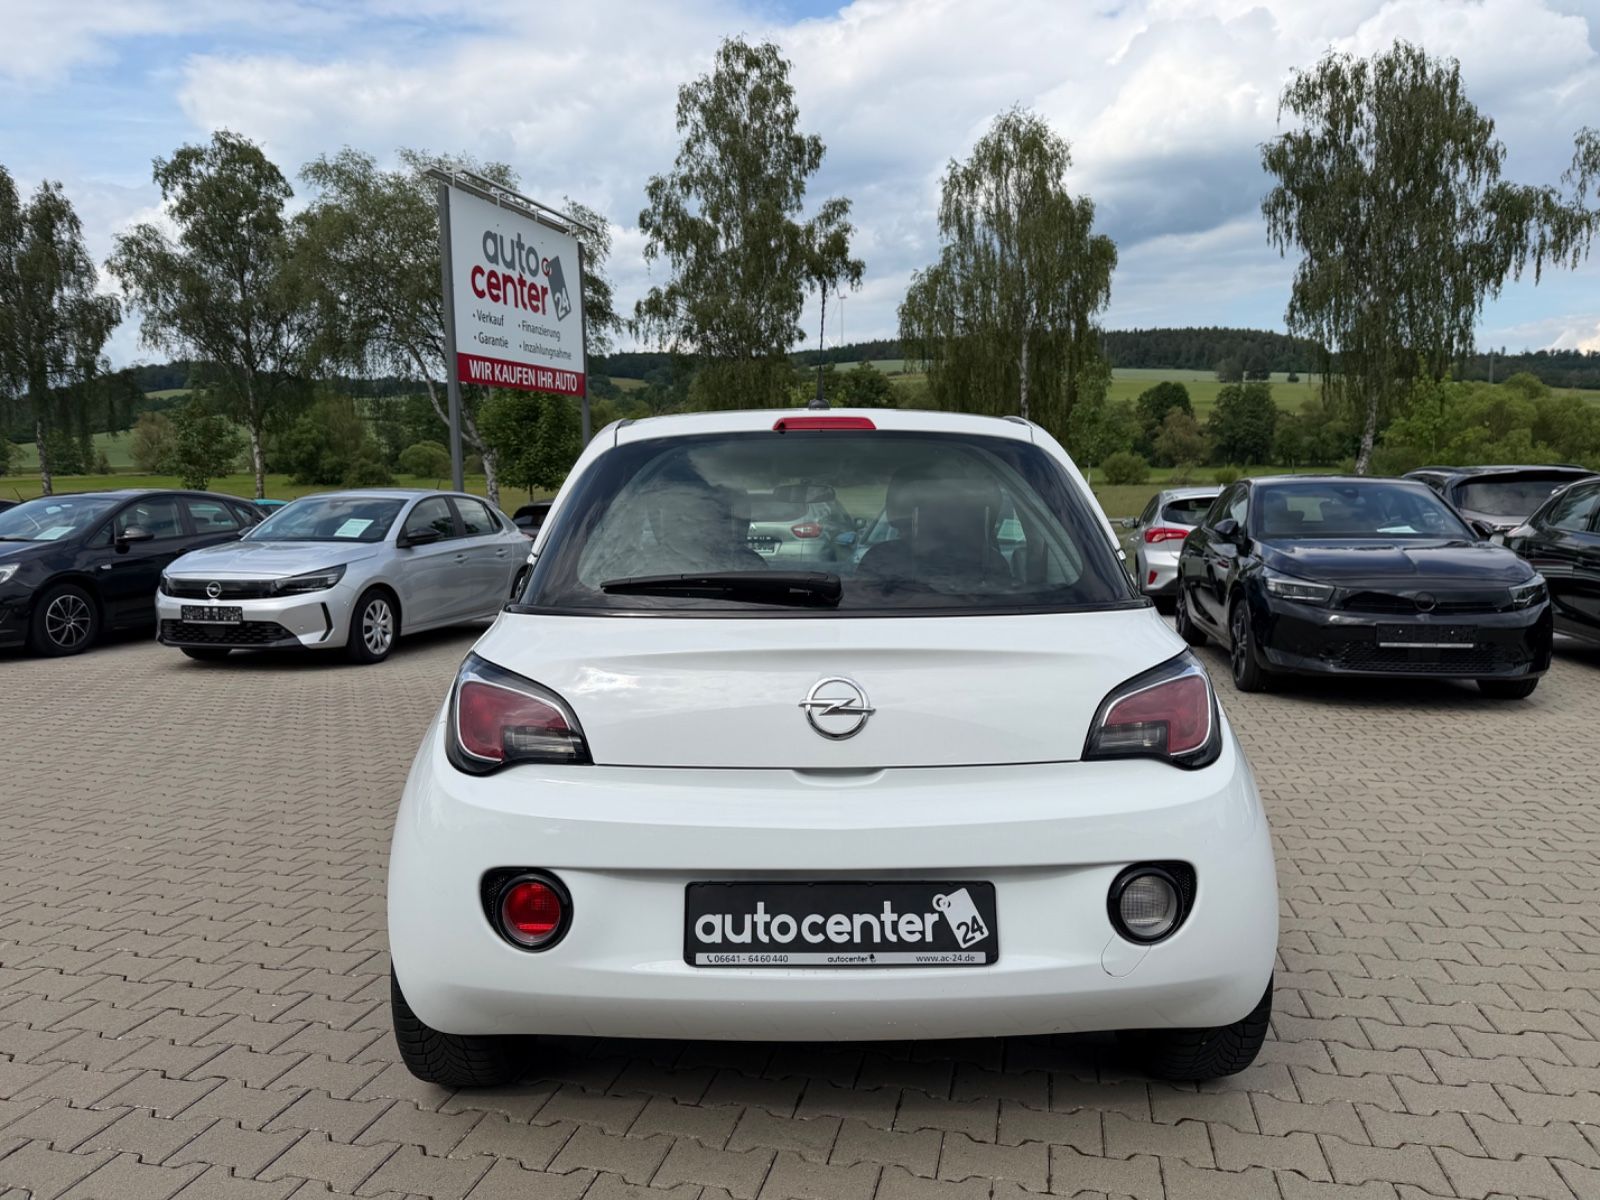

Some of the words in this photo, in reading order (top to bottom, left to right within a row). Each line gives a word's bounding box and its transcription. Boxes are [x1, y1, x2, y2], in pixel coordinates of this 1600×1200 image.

[482, 230, 540, 278] auto
[471, 265, 549, 316] center
[554, 287, 571, 320] 24
[476, 309, 504, 327] Verkauf
[478, 331, 509, 349] Garantie
[521, 320, 561, 342] Finanzierung
[522, 341, 572, 360] Inzahlungnahme
[468, 359, 493, 381] WIR
[494, 363, 536, 386] KAUFEN
[537, 370, 554, 389] IHR
[555, 371, 578, 392] AUTO
[956, 915, 985, 944] 24
[714, 954, 741, 963] 06641
[915, 954, 976, 963] www.ac-24.de
